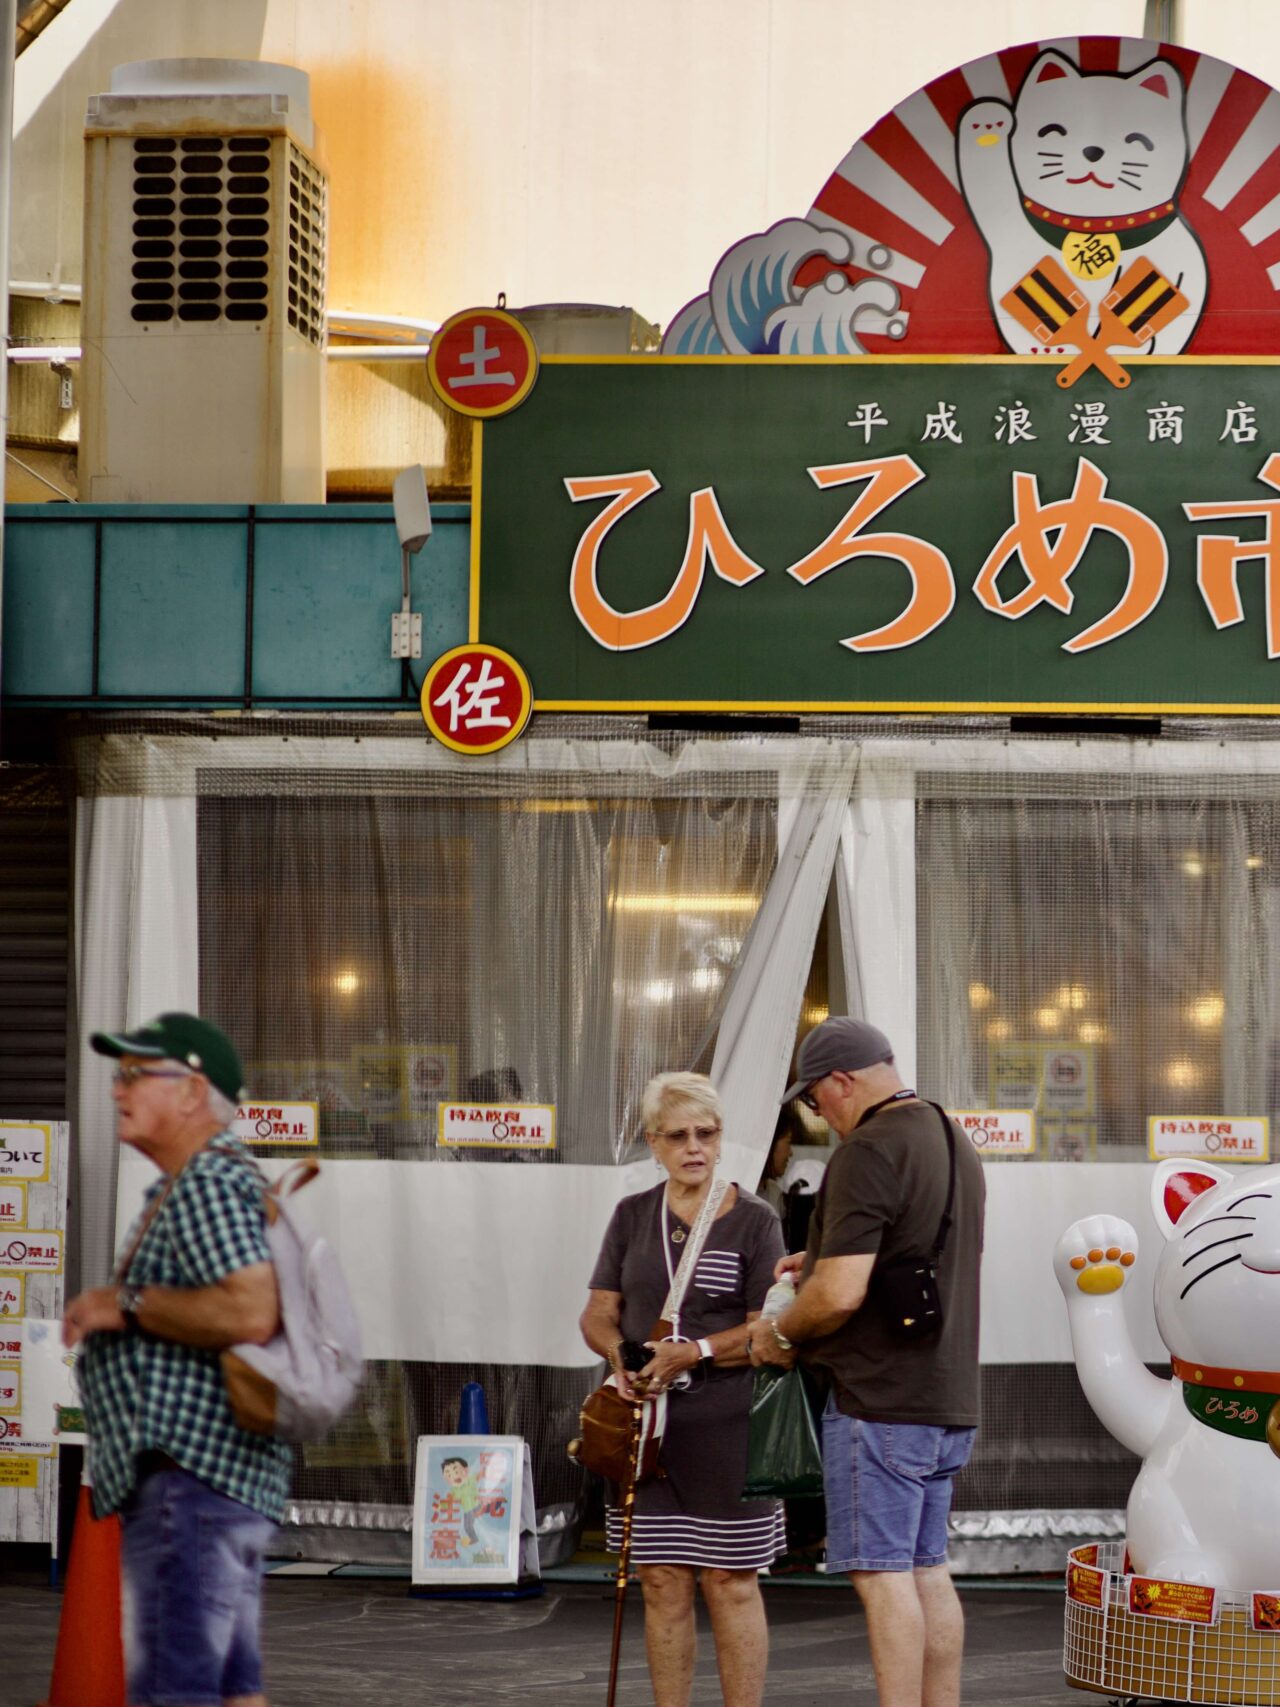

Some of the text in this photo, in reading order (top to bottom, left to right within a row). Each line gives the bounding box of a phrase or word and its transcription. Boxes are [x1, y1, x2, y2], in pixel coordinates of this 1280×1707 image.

[1072, 232, 1116, 276] 福
[448, 326, 516, 390] 土
[433, 659, 512, 732] 佐
[1205, 1397, 1259, 1425] ひろめ
[429, 1492, 462, 1561] 注意
